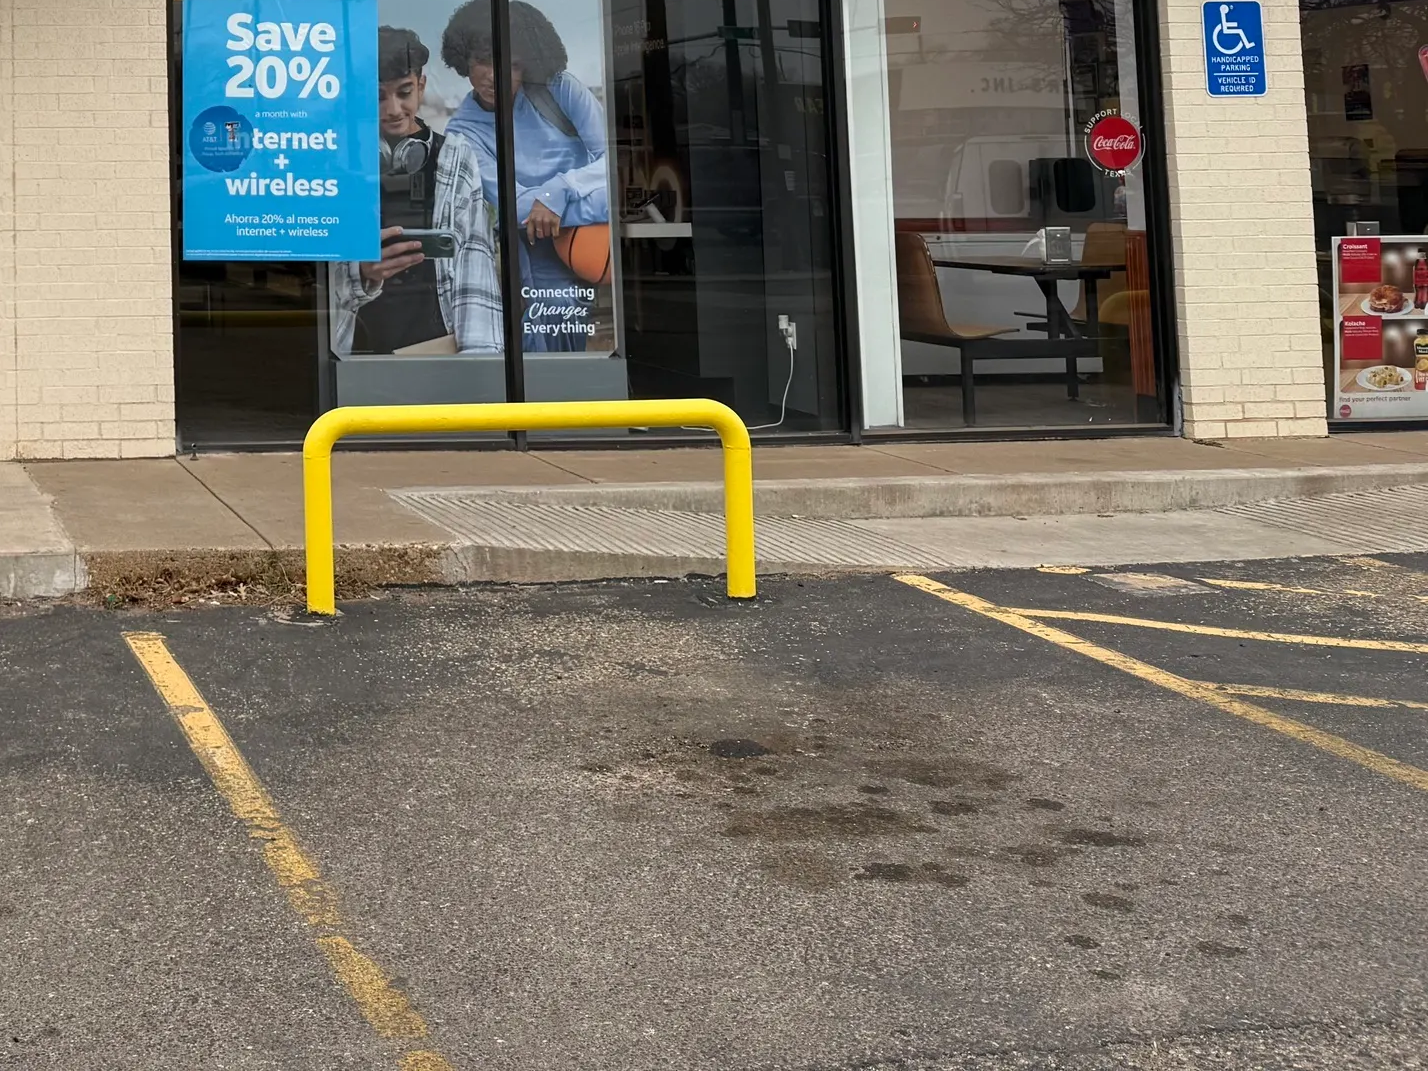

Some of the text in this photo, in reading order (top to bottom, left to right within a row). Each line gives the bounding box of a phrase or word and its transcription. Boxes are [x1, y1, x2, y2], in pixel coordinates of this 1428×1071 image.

[225, 12, 336, 53] Save
[1211, 55, 1260, 63] HANDICAPPED
[225, 55, 341, 100] 20%
[1217, 76, 1257, 84] VEHICLE ID
[1220, 84, 1254, 92] REQUIRED
[261, 110, 289, 118] month
[290, 110, 308, 118] with
[1084, 108, 1143, 134] SUPPORT LOC
[274, 153, 289, 169] +
[225, 172, 339, 197] wireless
[224, 214, 340, 224] Ahorra 20% al mes con
[236, 226, 277, 236] internet
[288, 227, 329, 237] wireless
[521, 285, 595, 300] Connecting
[528, 302, 589, 320] Changes
